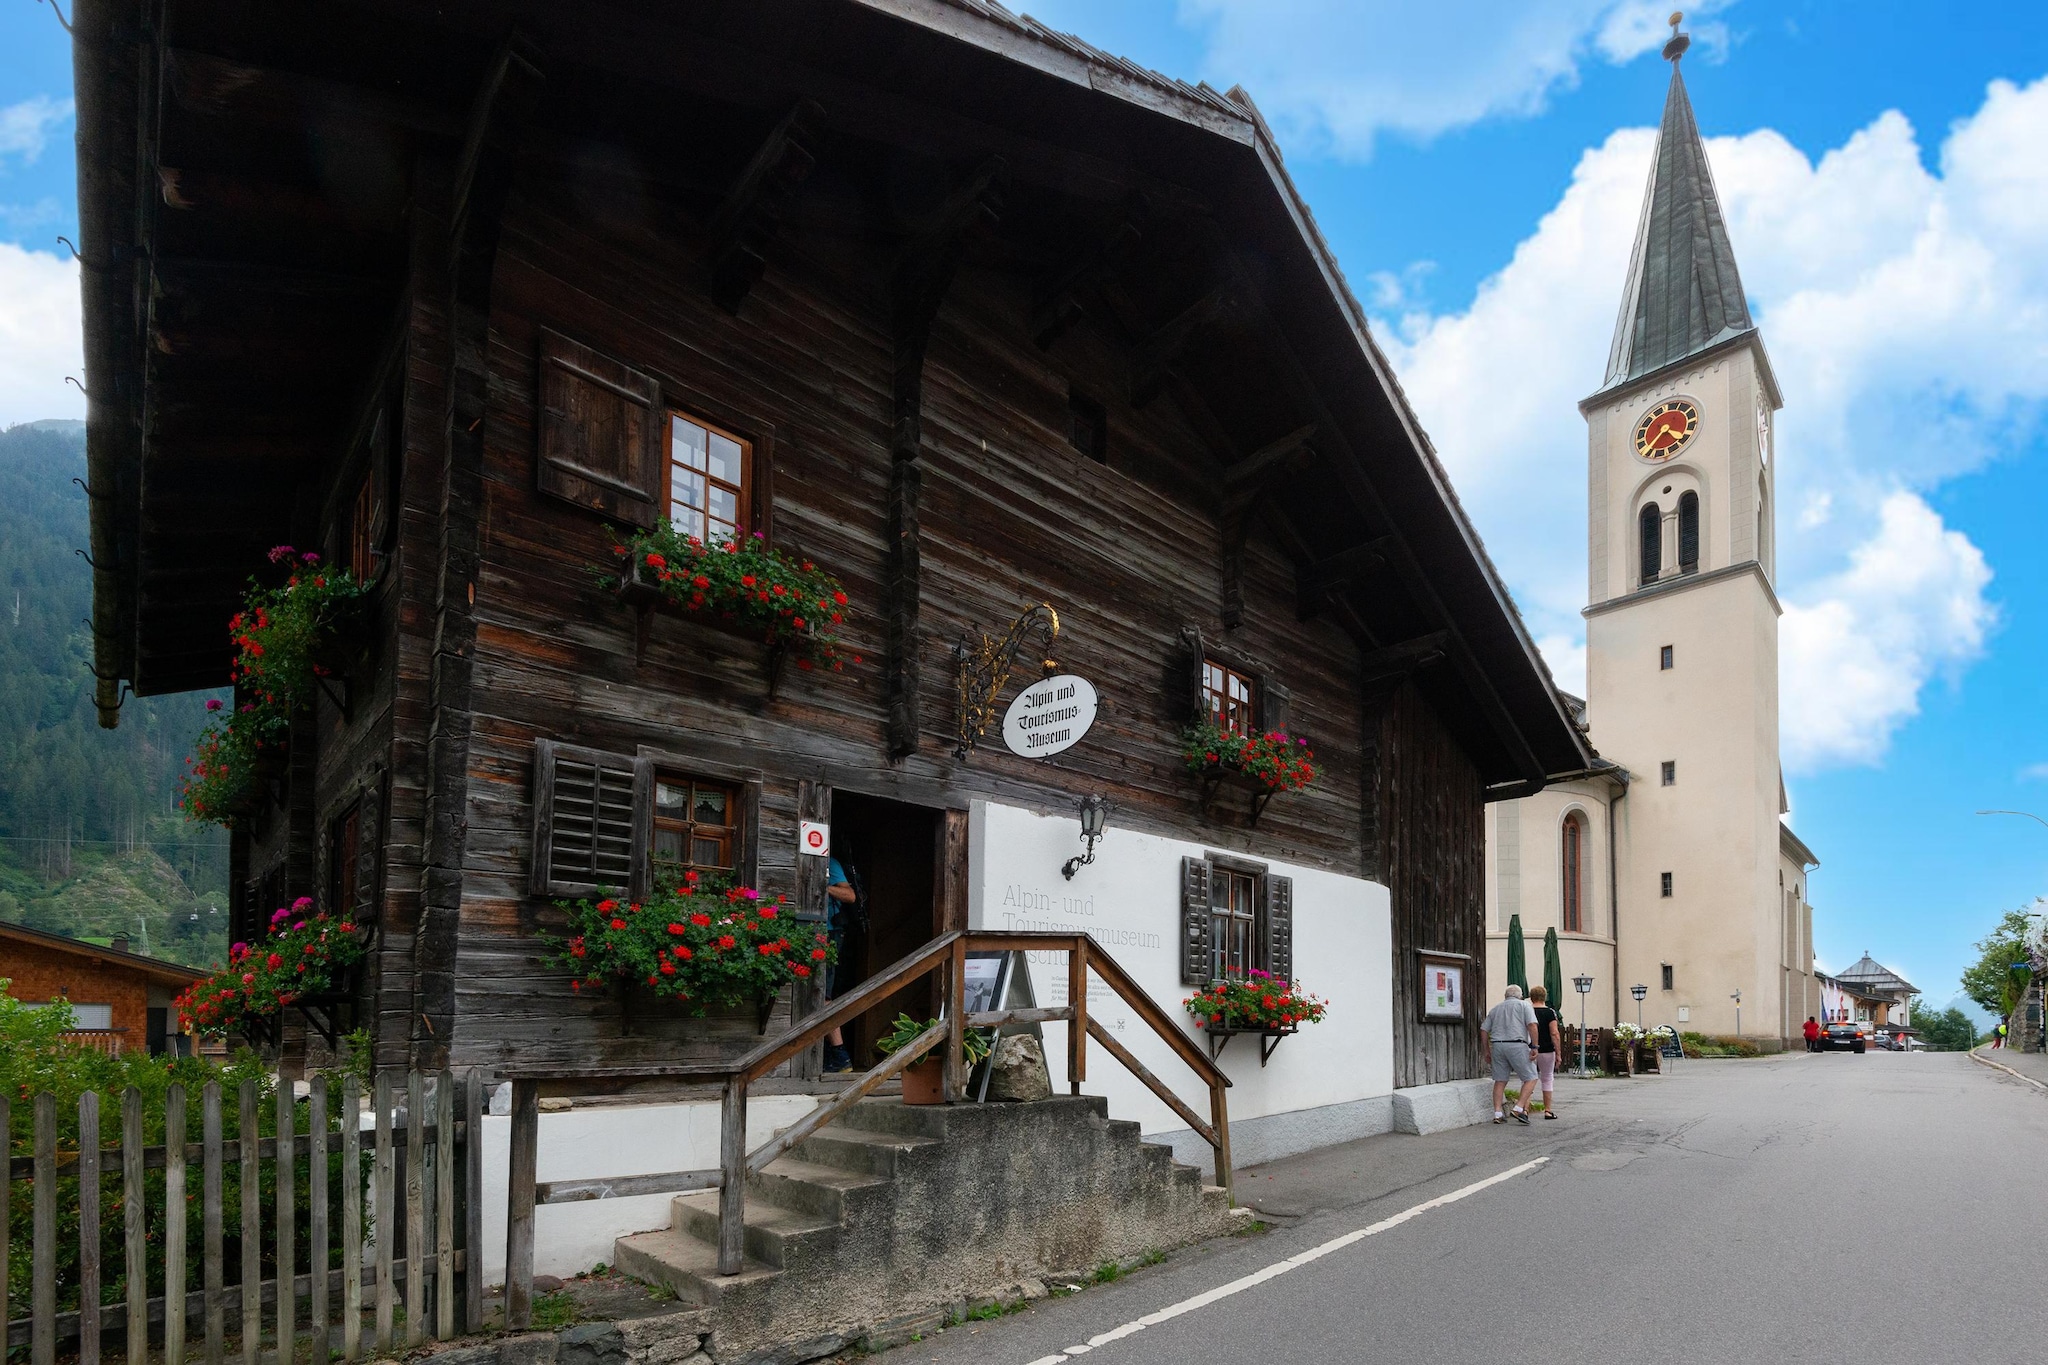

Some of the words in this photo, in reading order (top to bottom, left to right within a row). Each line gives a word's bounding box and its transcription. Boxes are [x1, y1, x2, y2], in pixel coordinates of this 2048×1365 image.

[1024, 689, 1053, 709] Alpin
[1057, 682, 1075, 701] und
[1027, 728, 1070, 749] Museum
[1003, 884, 1057, 914] Alpin-
[1063, 895, 1094, 916] und
